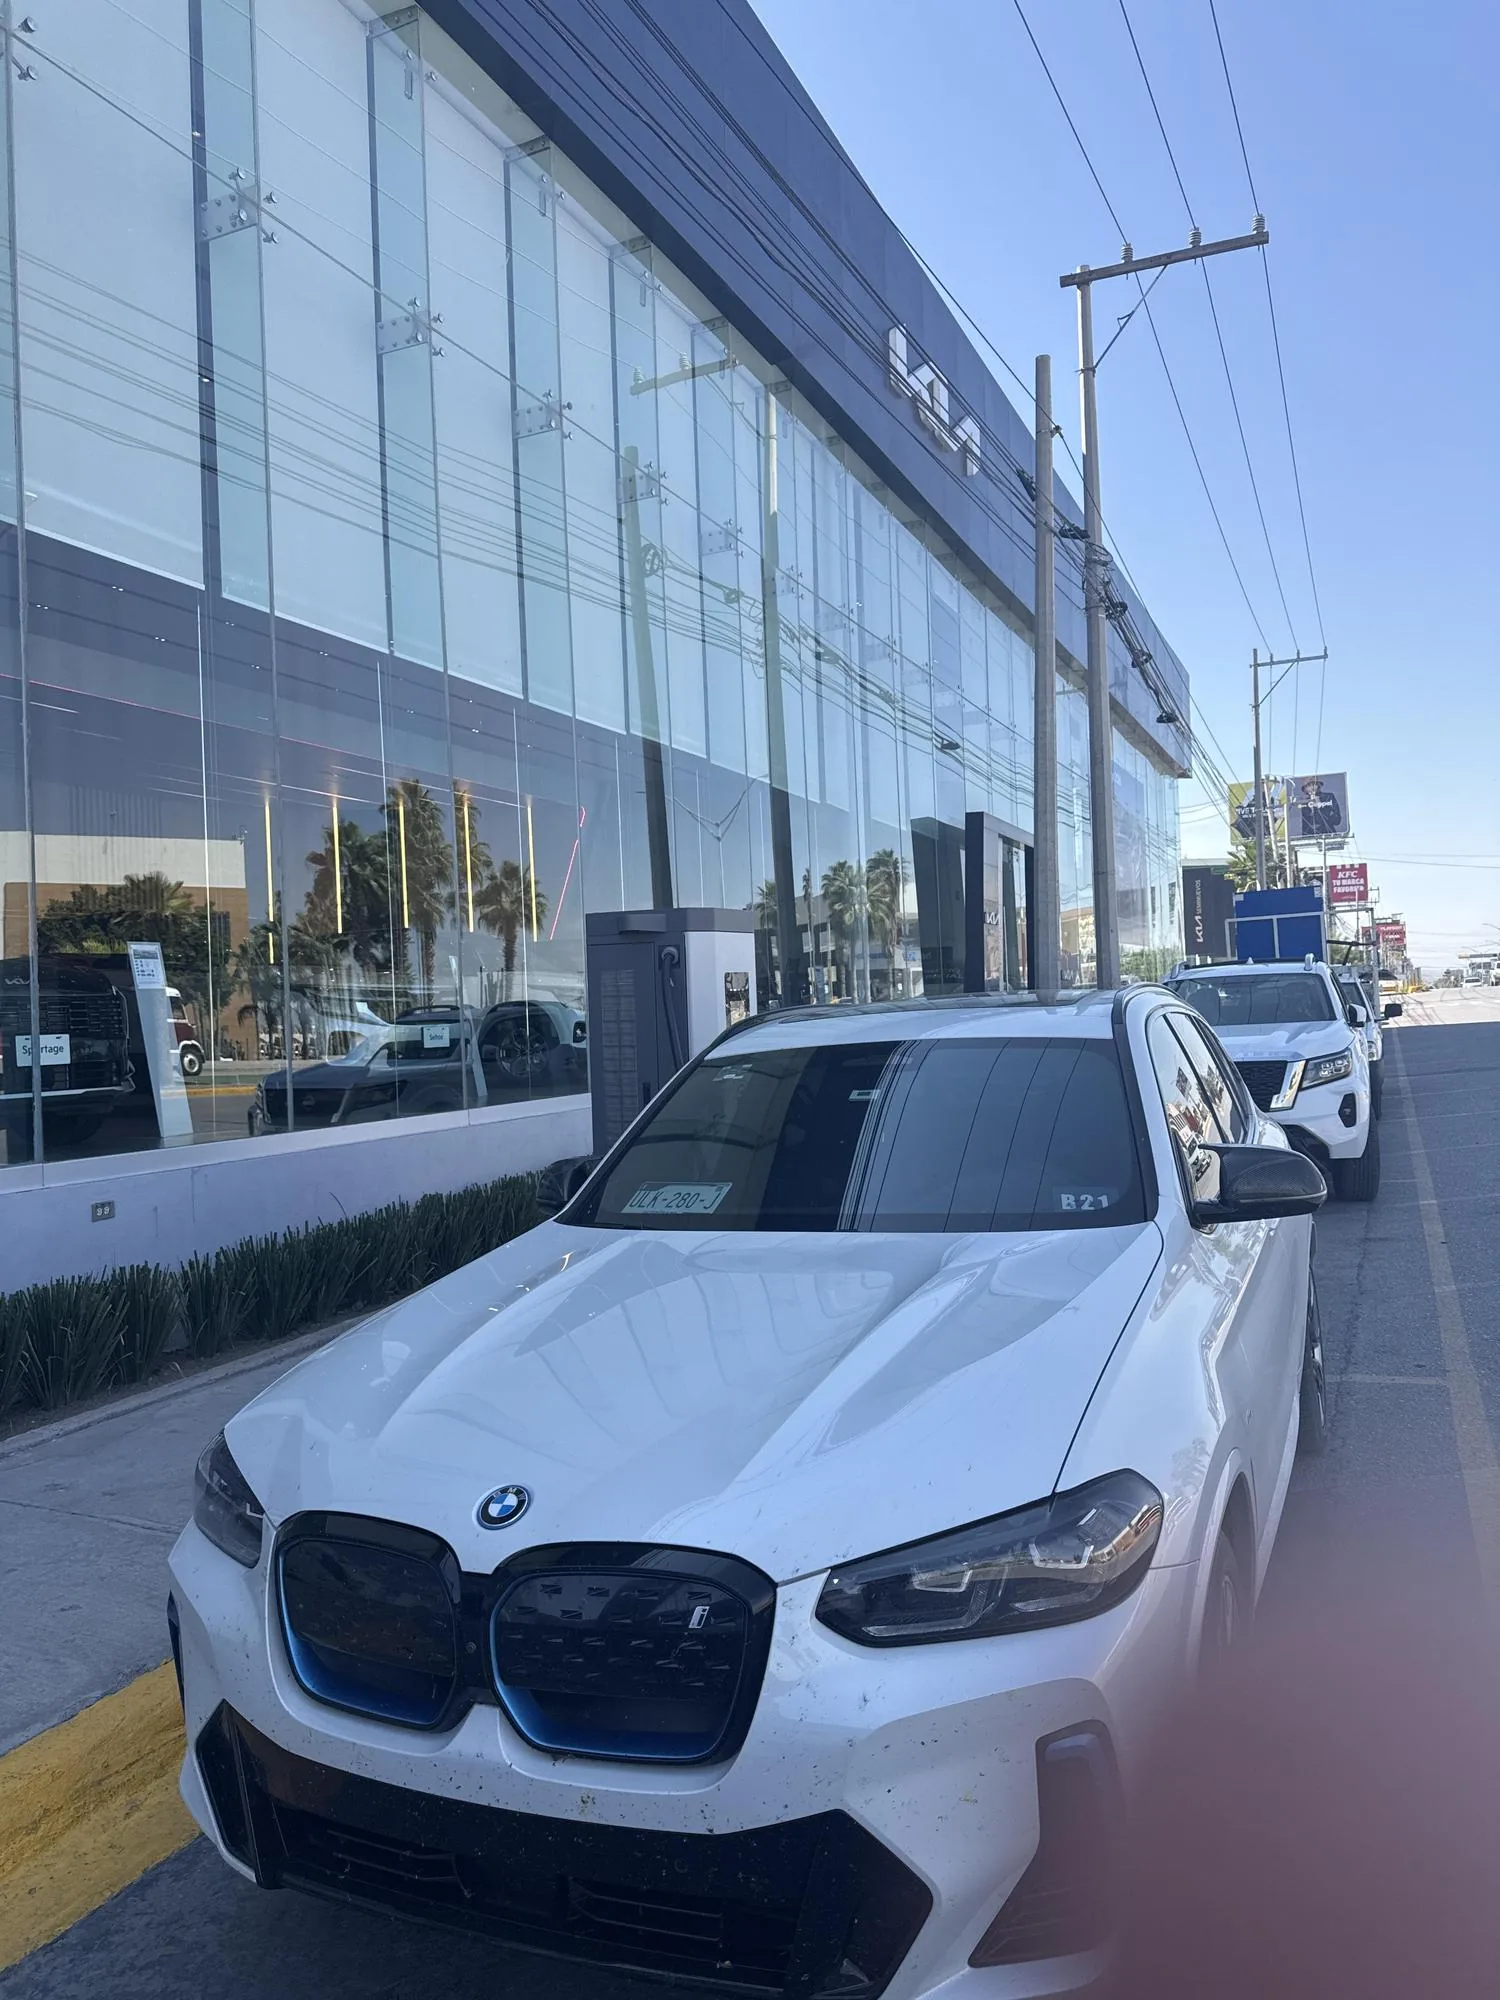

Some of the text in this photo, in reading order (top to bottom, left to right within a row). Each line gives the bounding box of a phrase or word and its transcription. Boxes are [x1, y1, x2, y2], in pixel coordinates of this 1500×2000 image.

[1337, 870, 1358, 879] KFC
[22, 1045, 64, 1055] Sprtage
[1061, 1194, 1109, 1210] B21
